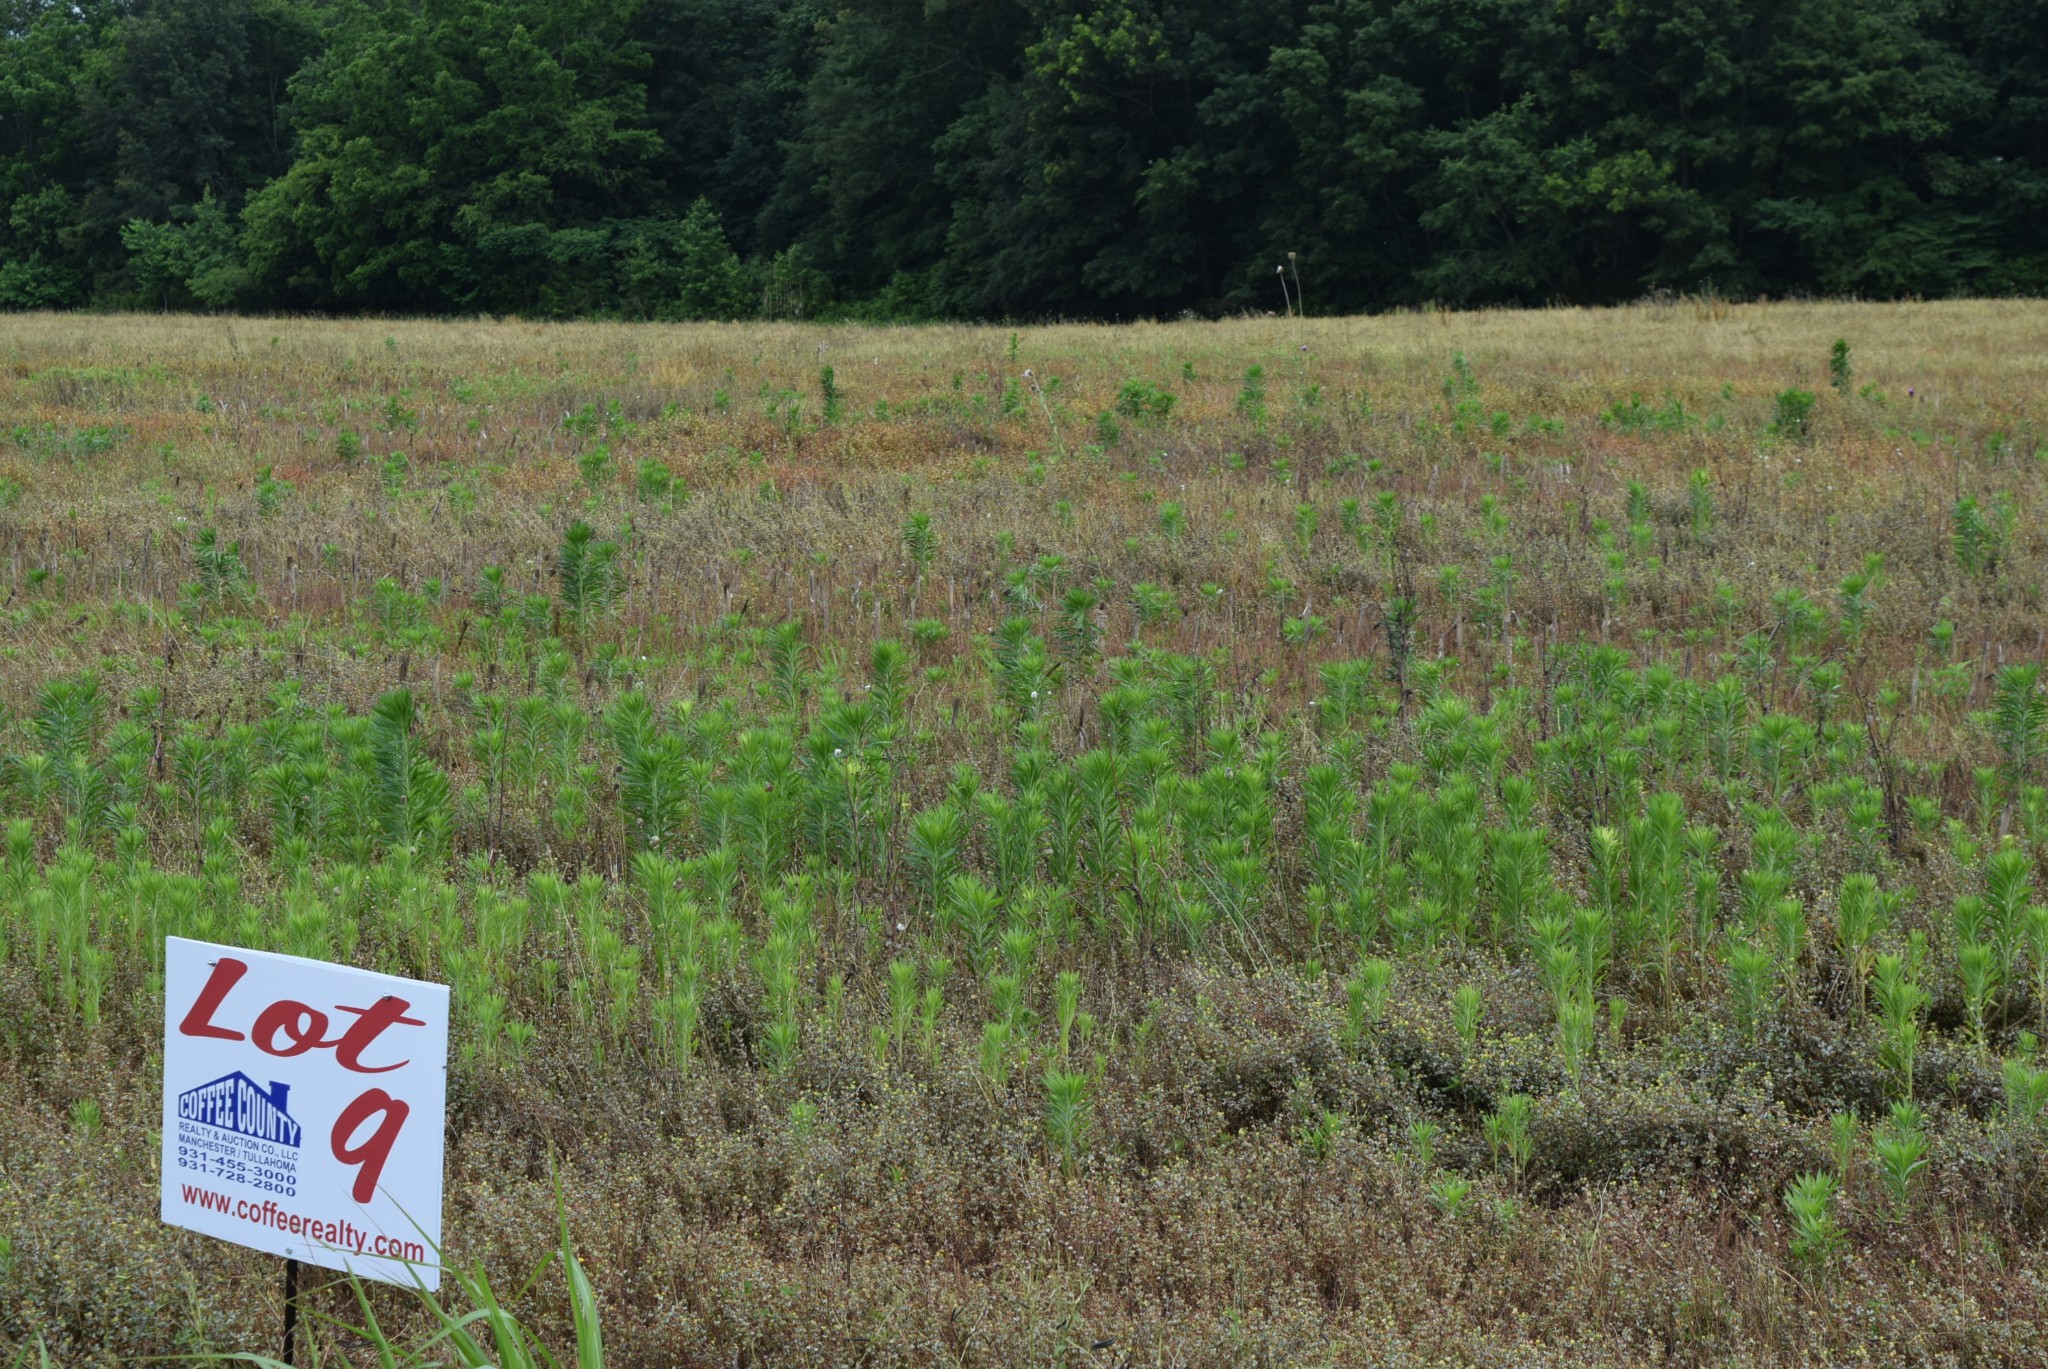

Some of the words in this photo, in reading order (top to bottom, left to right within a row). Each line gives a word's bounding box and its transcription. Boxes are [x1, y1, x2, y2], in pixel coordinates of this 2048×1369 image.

[179, 957, 426, 1074] Lot
[180, 1078, 235, 1129] COFFEE
[237, 1078, 299, 1146] COUNTY
[178, 1145, 297, 1186] 931-455-3000
[179, 1121, 212, 1138] REALTY
[213, 1131, 219, 1141] &
[222, 1133, 259, 1151] AUCTION
[281, 1149, 298, 1161] LLC
[179, 1133, 236, 1157] MANCHESTER
[243, 1150, 297, 1173] TULLAHOMA
[331, 1088, 410, 1204] 9
[178, 1157, 296, 1197] 931-728-2800
[182, 1183, 425, 1263] www.coffeerealty.com
